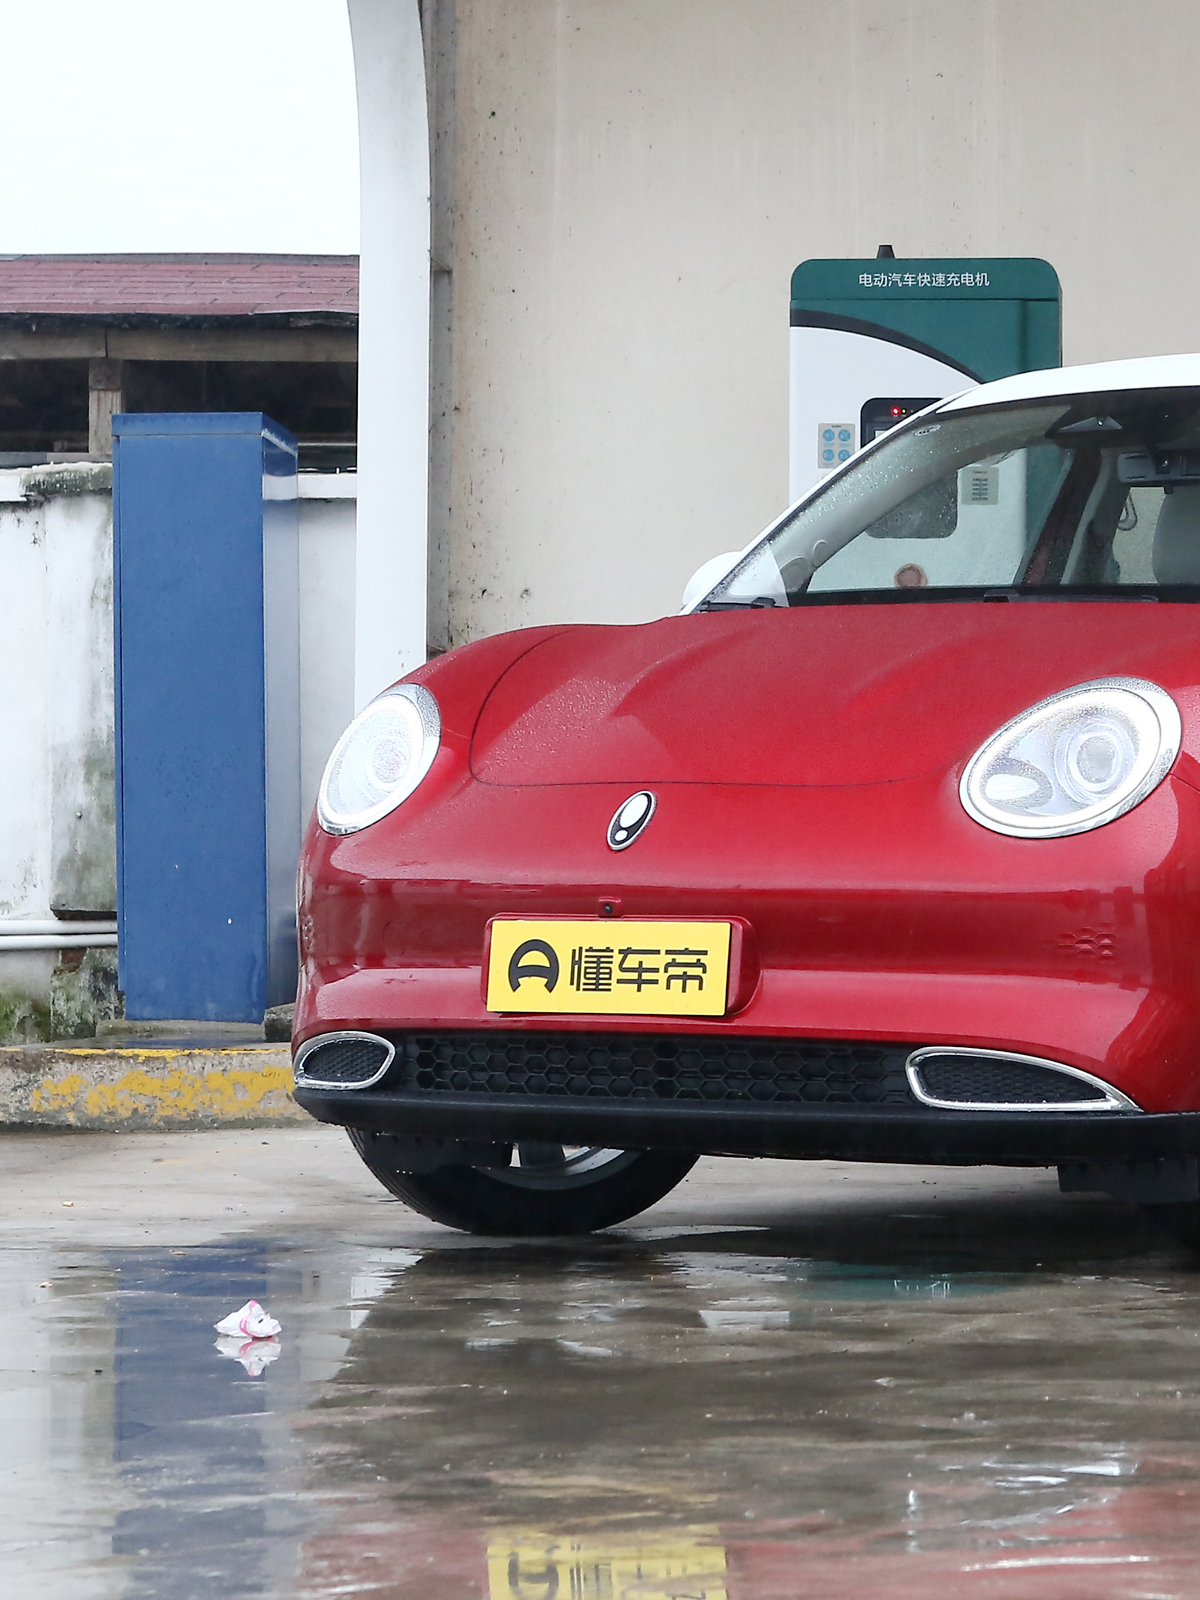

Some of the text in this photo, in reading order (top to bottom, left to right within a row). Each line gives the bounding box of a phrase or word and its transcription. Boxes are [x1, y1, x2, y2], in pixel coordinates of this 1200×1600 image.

[858, 272, 990, 287] 电动汽车快速充电机
[569, 946, 709, 993] 懂车帝
